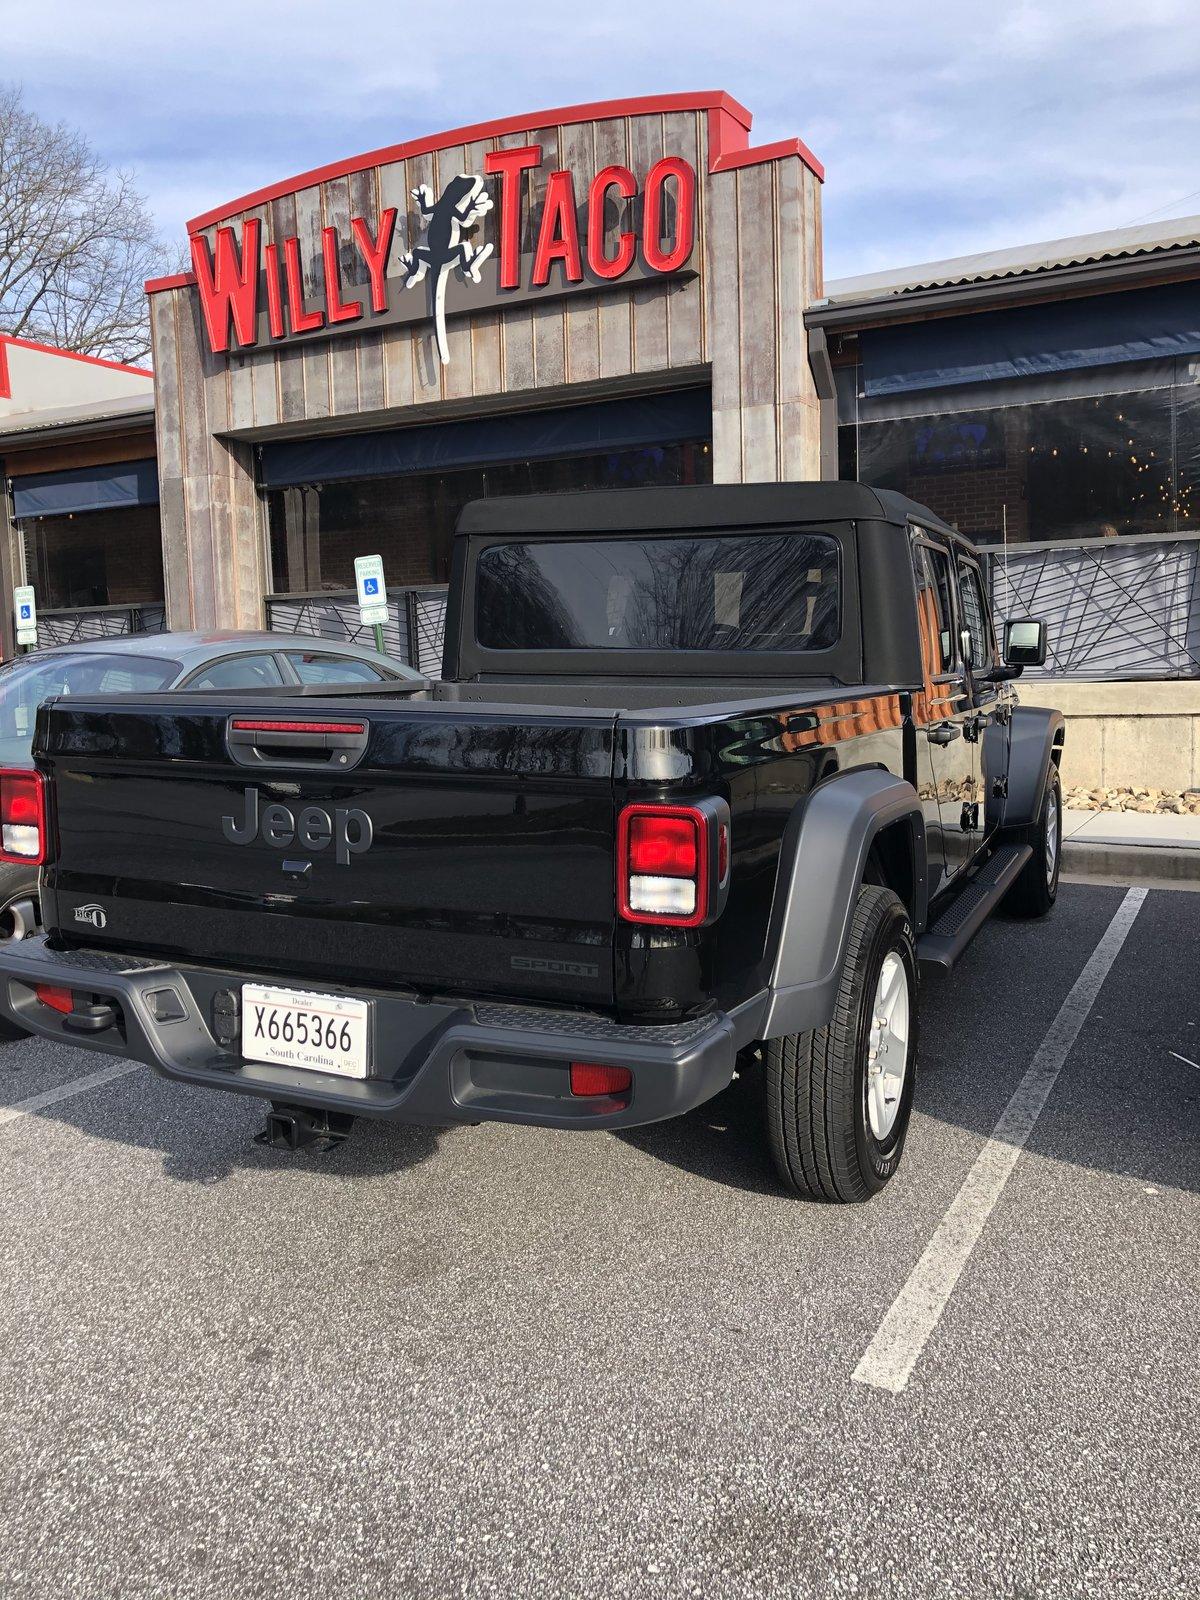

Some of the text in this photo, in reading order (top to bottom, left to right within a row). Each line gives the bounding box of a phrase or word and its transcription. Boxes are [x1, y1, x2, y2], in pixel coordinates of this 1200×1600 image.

[190, 144, 696, 353] WILLY TACO
[221, 787, 374, 866] Jeep
[511, 956, 599, 978] SPORT
[292, 997, 313, 1008] Dealer
[254, 1005, 352, 1053] X665366
[269, 1047, 334, 1067] South Carolina
